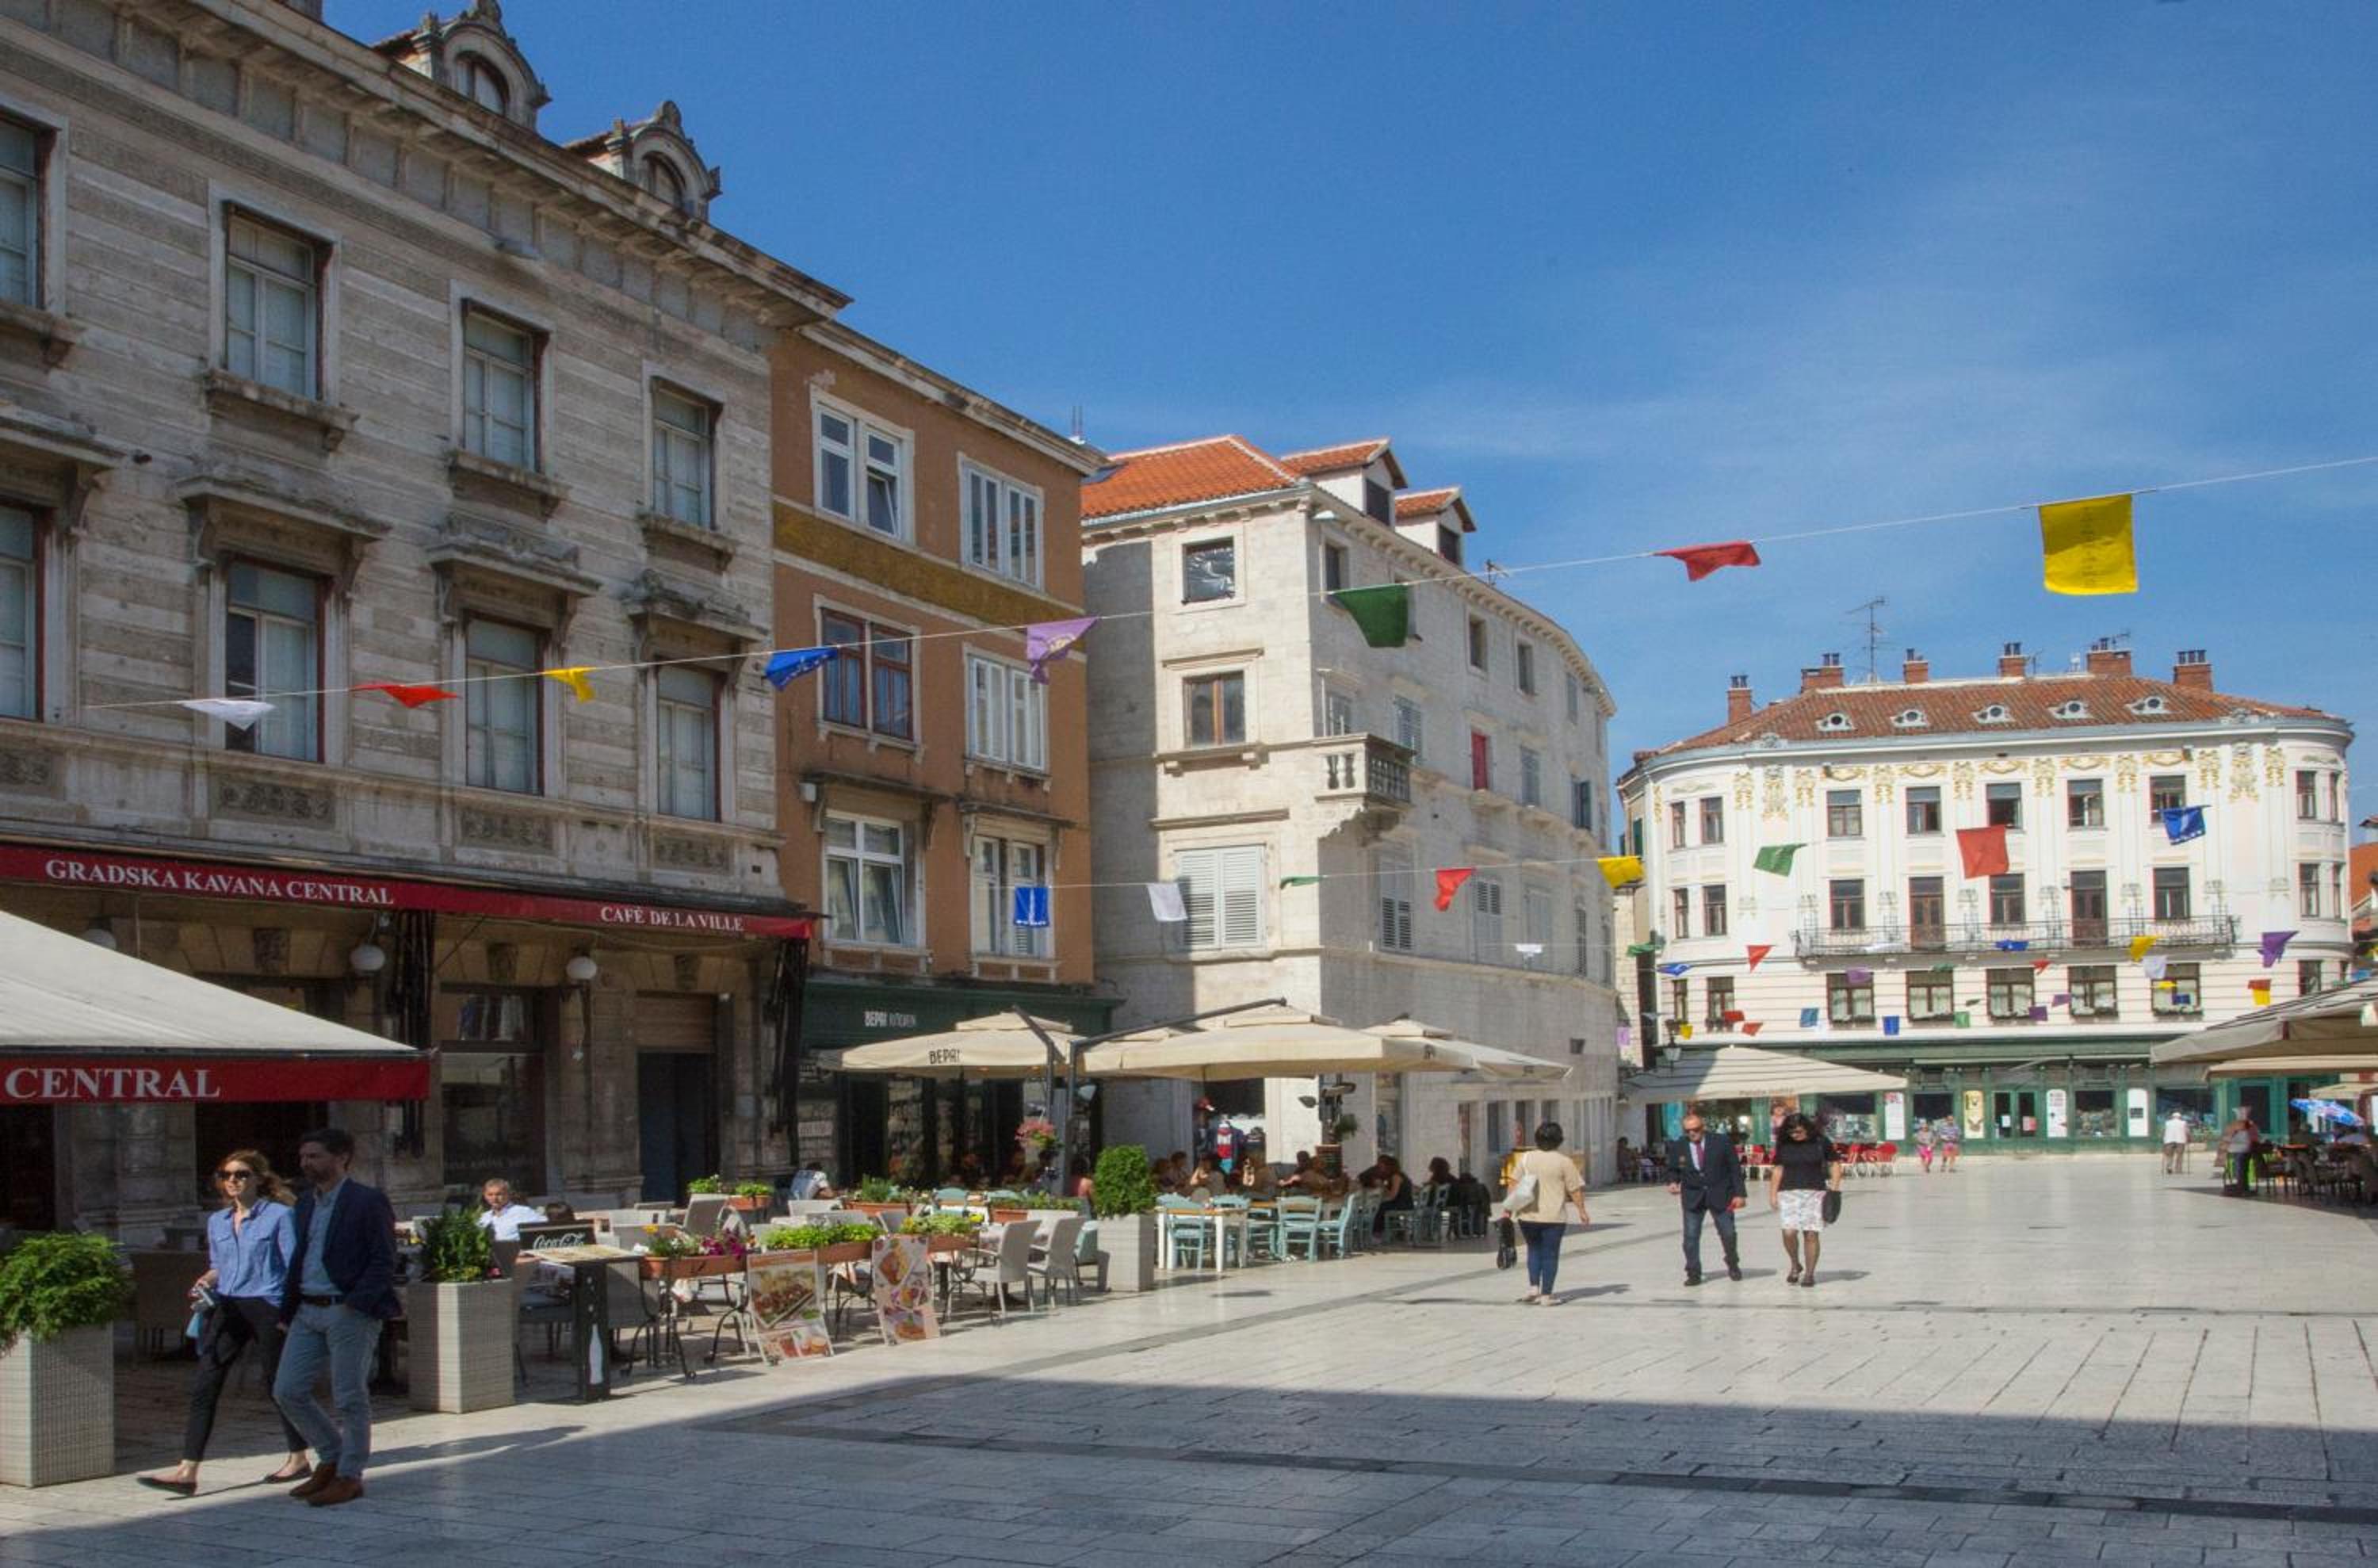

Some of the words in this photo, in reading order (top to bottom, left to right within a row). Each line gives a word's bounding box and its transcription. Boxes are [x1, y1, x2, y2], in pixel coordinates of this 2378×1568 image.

[45, 859, 178, 888] GRADSKA
[184, 871, 281, 897] KAVANA
[286, 882, 394, 904] CENTRAL
[650, 911, 671, 926] DE
[675, 912, 696, 927] LA
[698, 914, 745, 931] VILLE
[5, 1068, 221, 1099] CENTRAL
